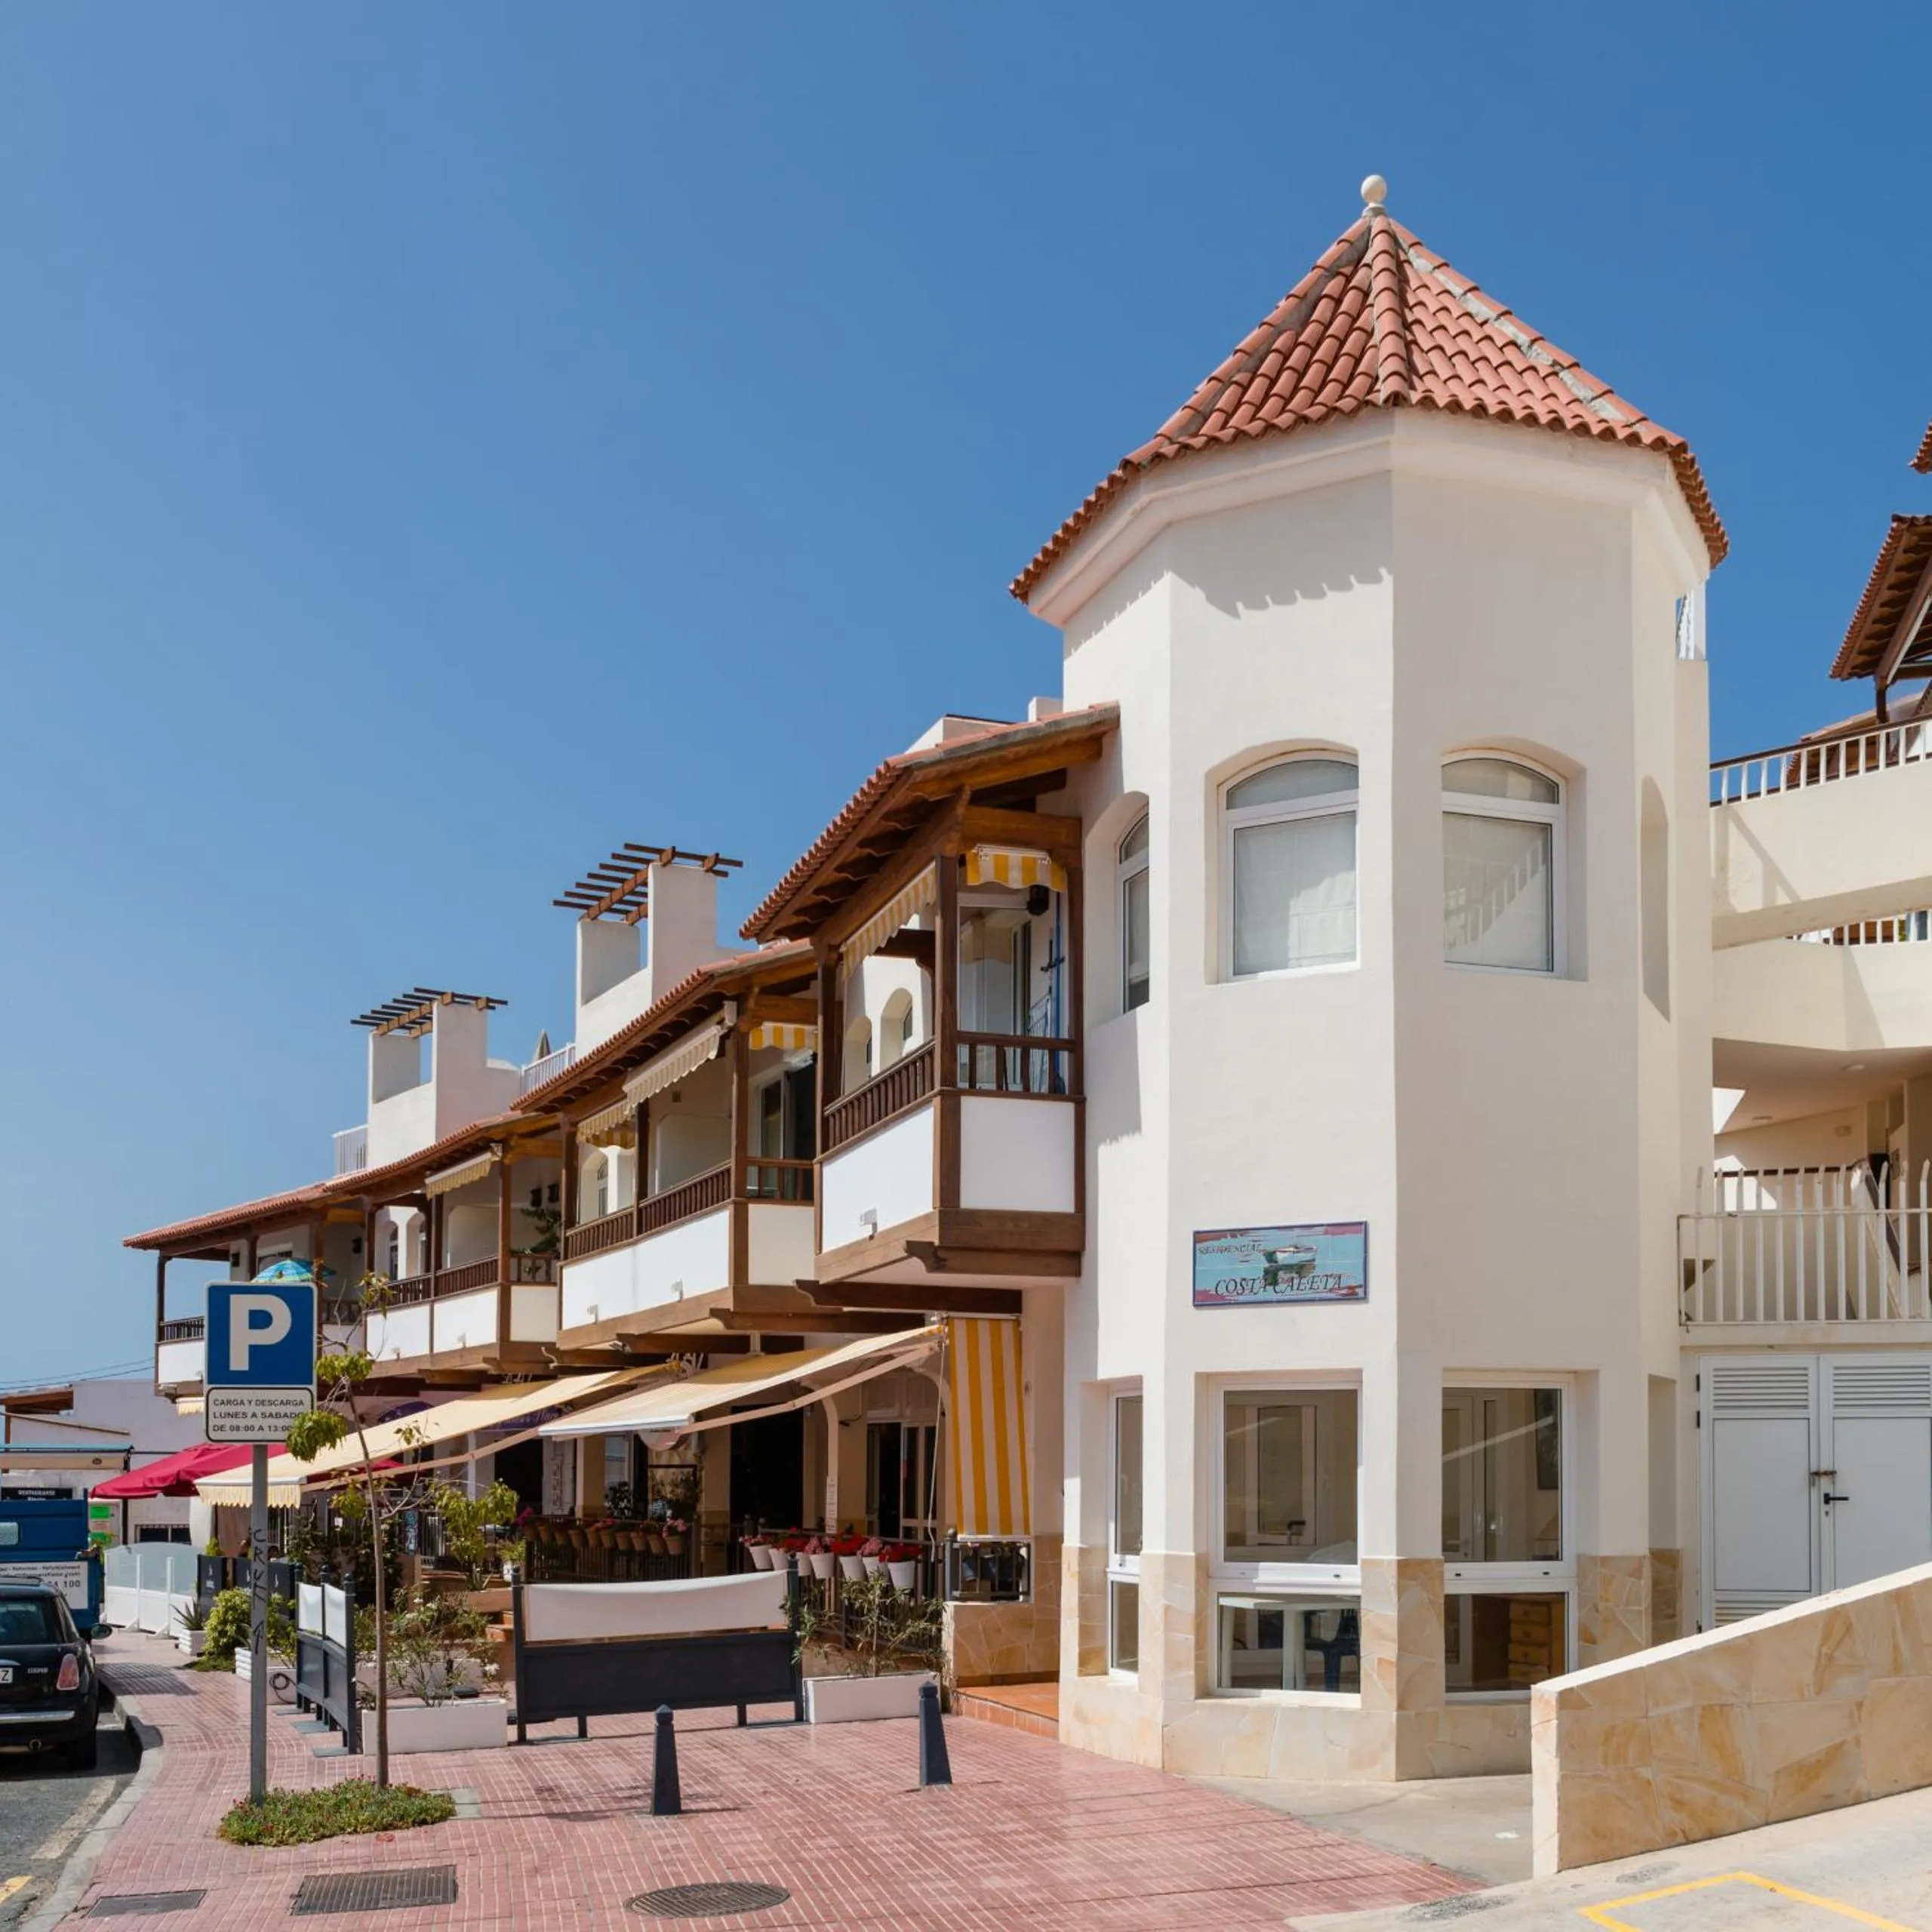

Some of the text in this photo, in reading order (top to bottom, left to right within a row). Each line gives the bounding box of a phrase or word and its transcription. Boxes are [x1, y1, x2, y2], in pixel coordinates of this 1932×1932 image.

[1215, 1273, 1343, 1295] COSTA CALETA
[229, 1294, 292, 1371] P
[213, 1398, 245, 1407] CARGA
[212, 1424, 227, 1432] DE
[229, 1424, 255, 1432] 08:00
[257, 1424, 265, 1432] A
